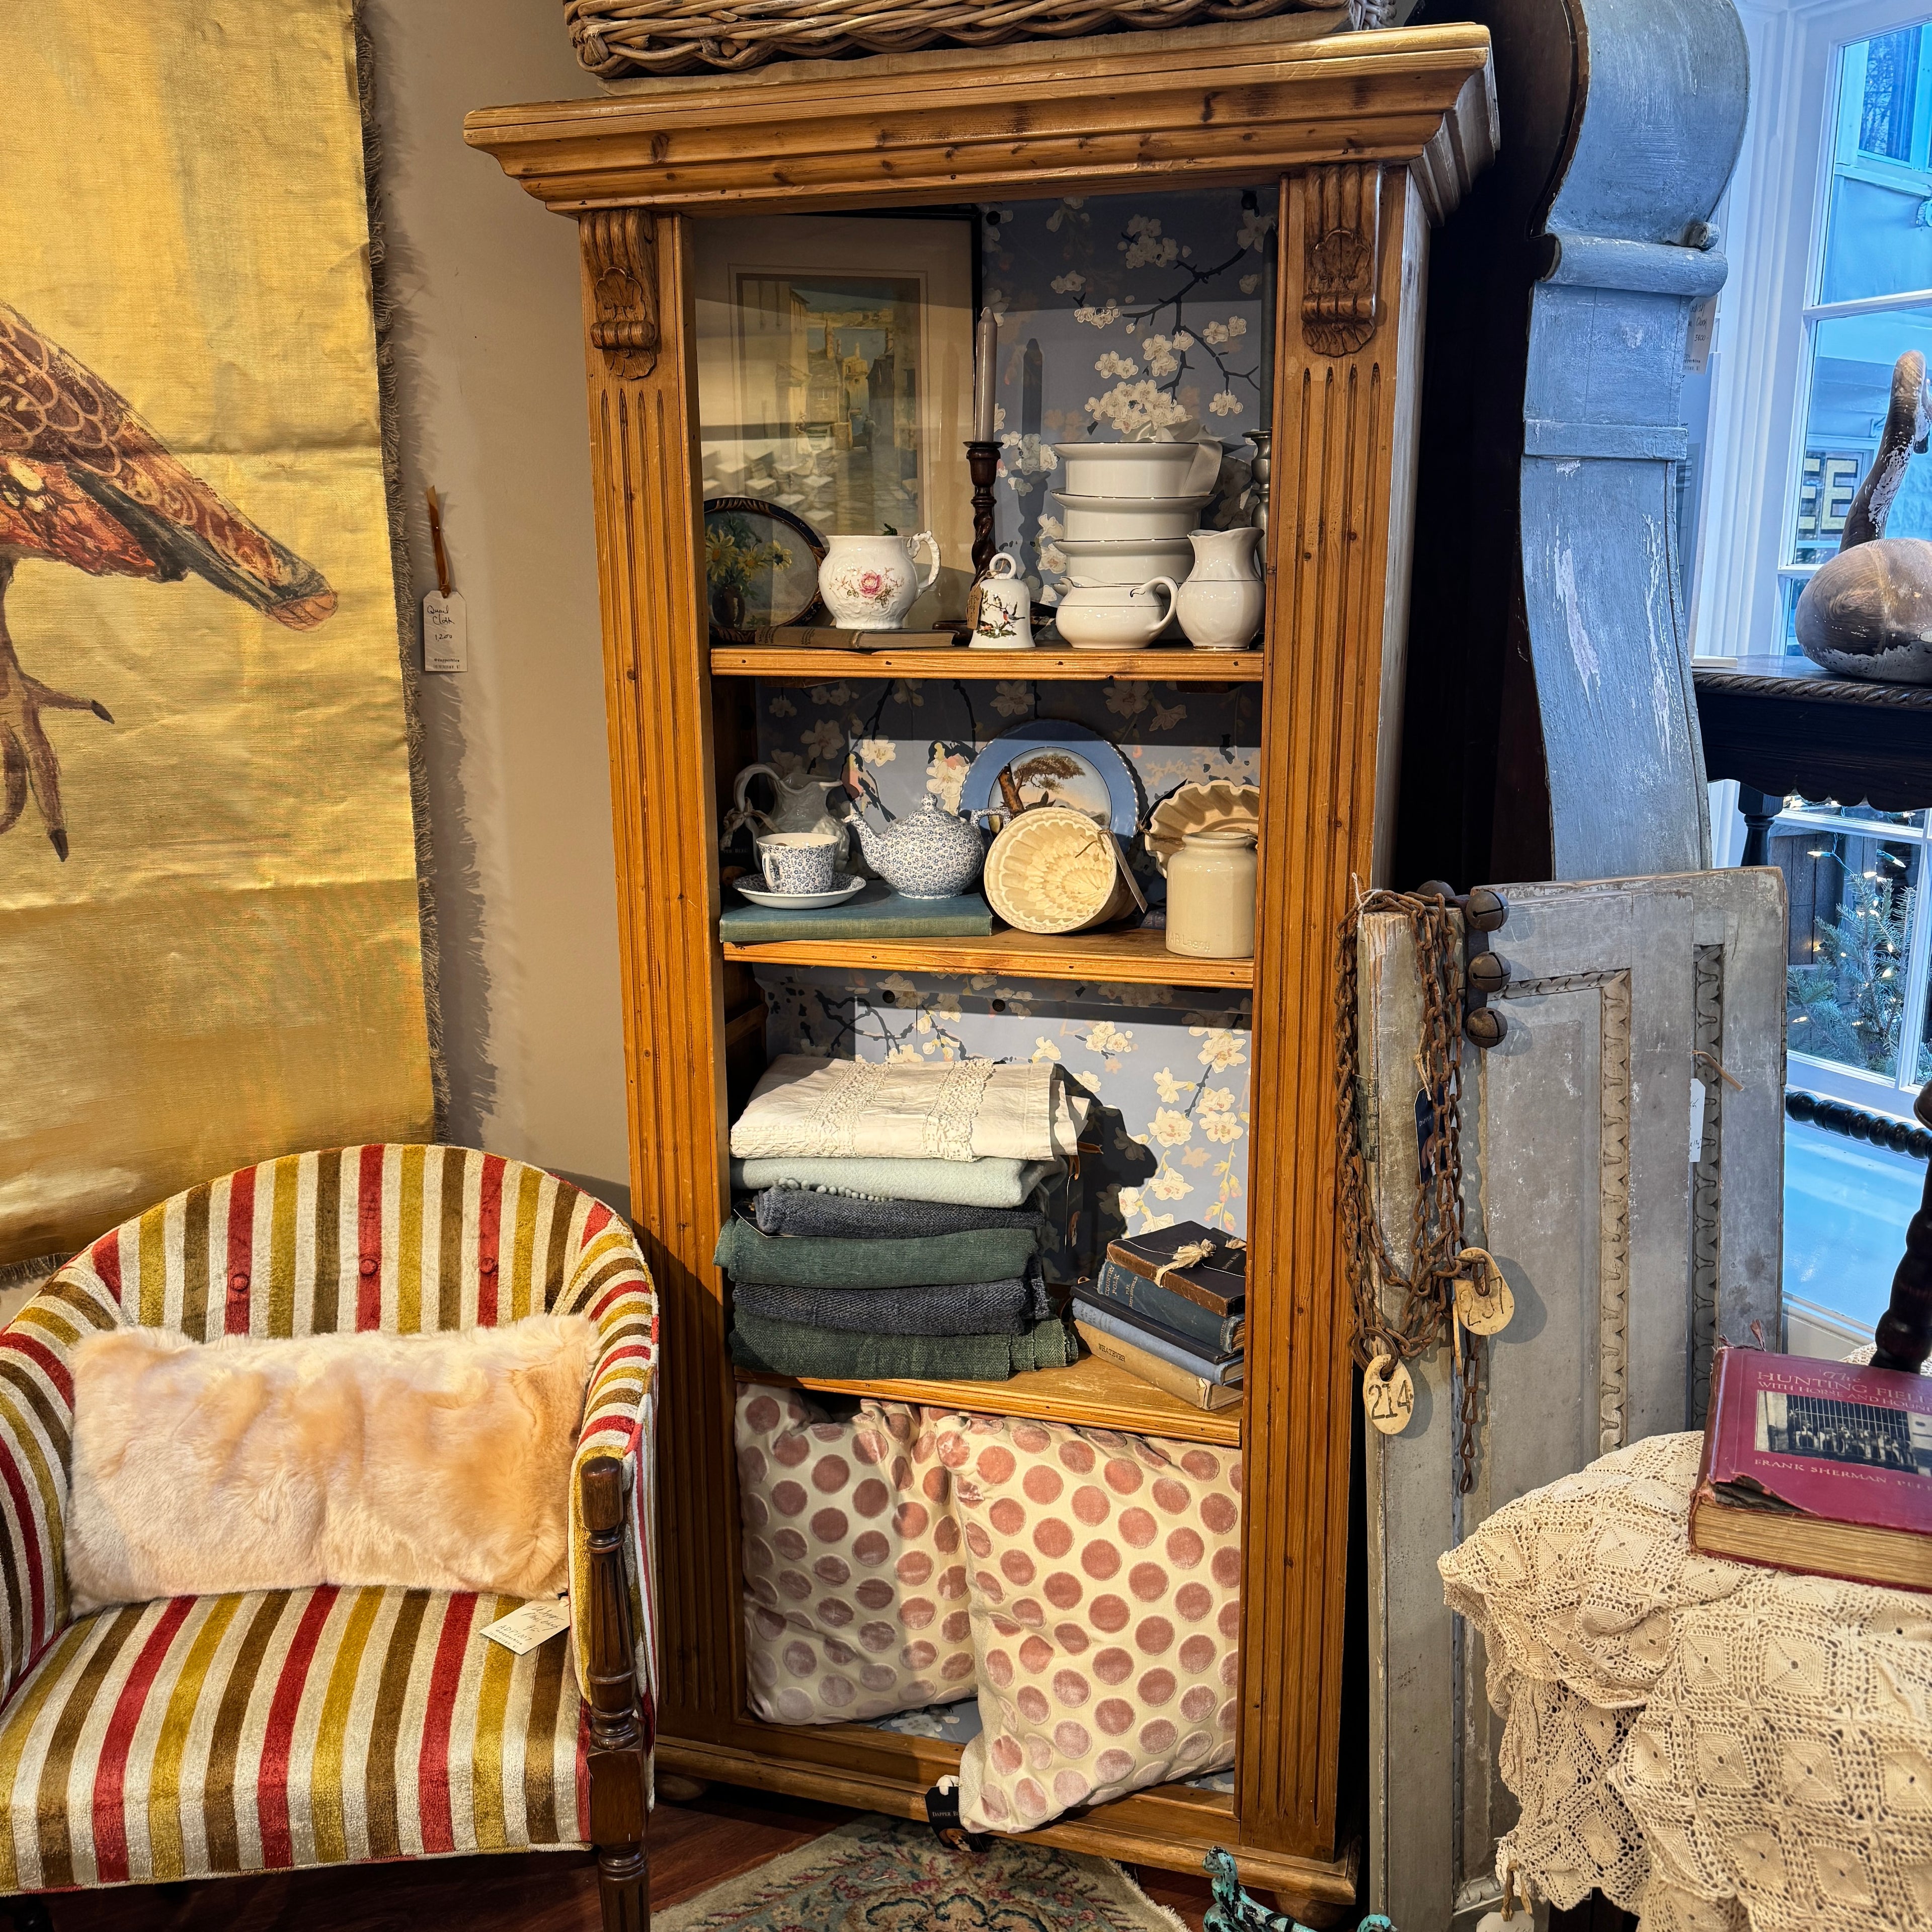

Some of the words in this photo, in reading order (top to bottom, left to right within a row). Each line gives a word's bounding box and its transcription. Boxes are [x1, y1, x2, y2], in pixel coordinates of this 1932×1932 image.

[1105, 1265, 1114, 1296] COUNTRY
[1098, 1343, 1126, 1362] WHATEVER
[1757, 1371, 1868, 1394] HUNTING
[1823, 1371, 1862, 1383] The
[1368, 1380, 1412, 1420] 214
[1758, 1381, 1794, 1391] WITH
[1799, 1386, 1844, 1398] HORSE
[1847, 1393, 1879, 1402] AND
[1754, 1459, 1805, 1471] FRANK
[1810, 1466, 1888, 1483] SHERMAN
